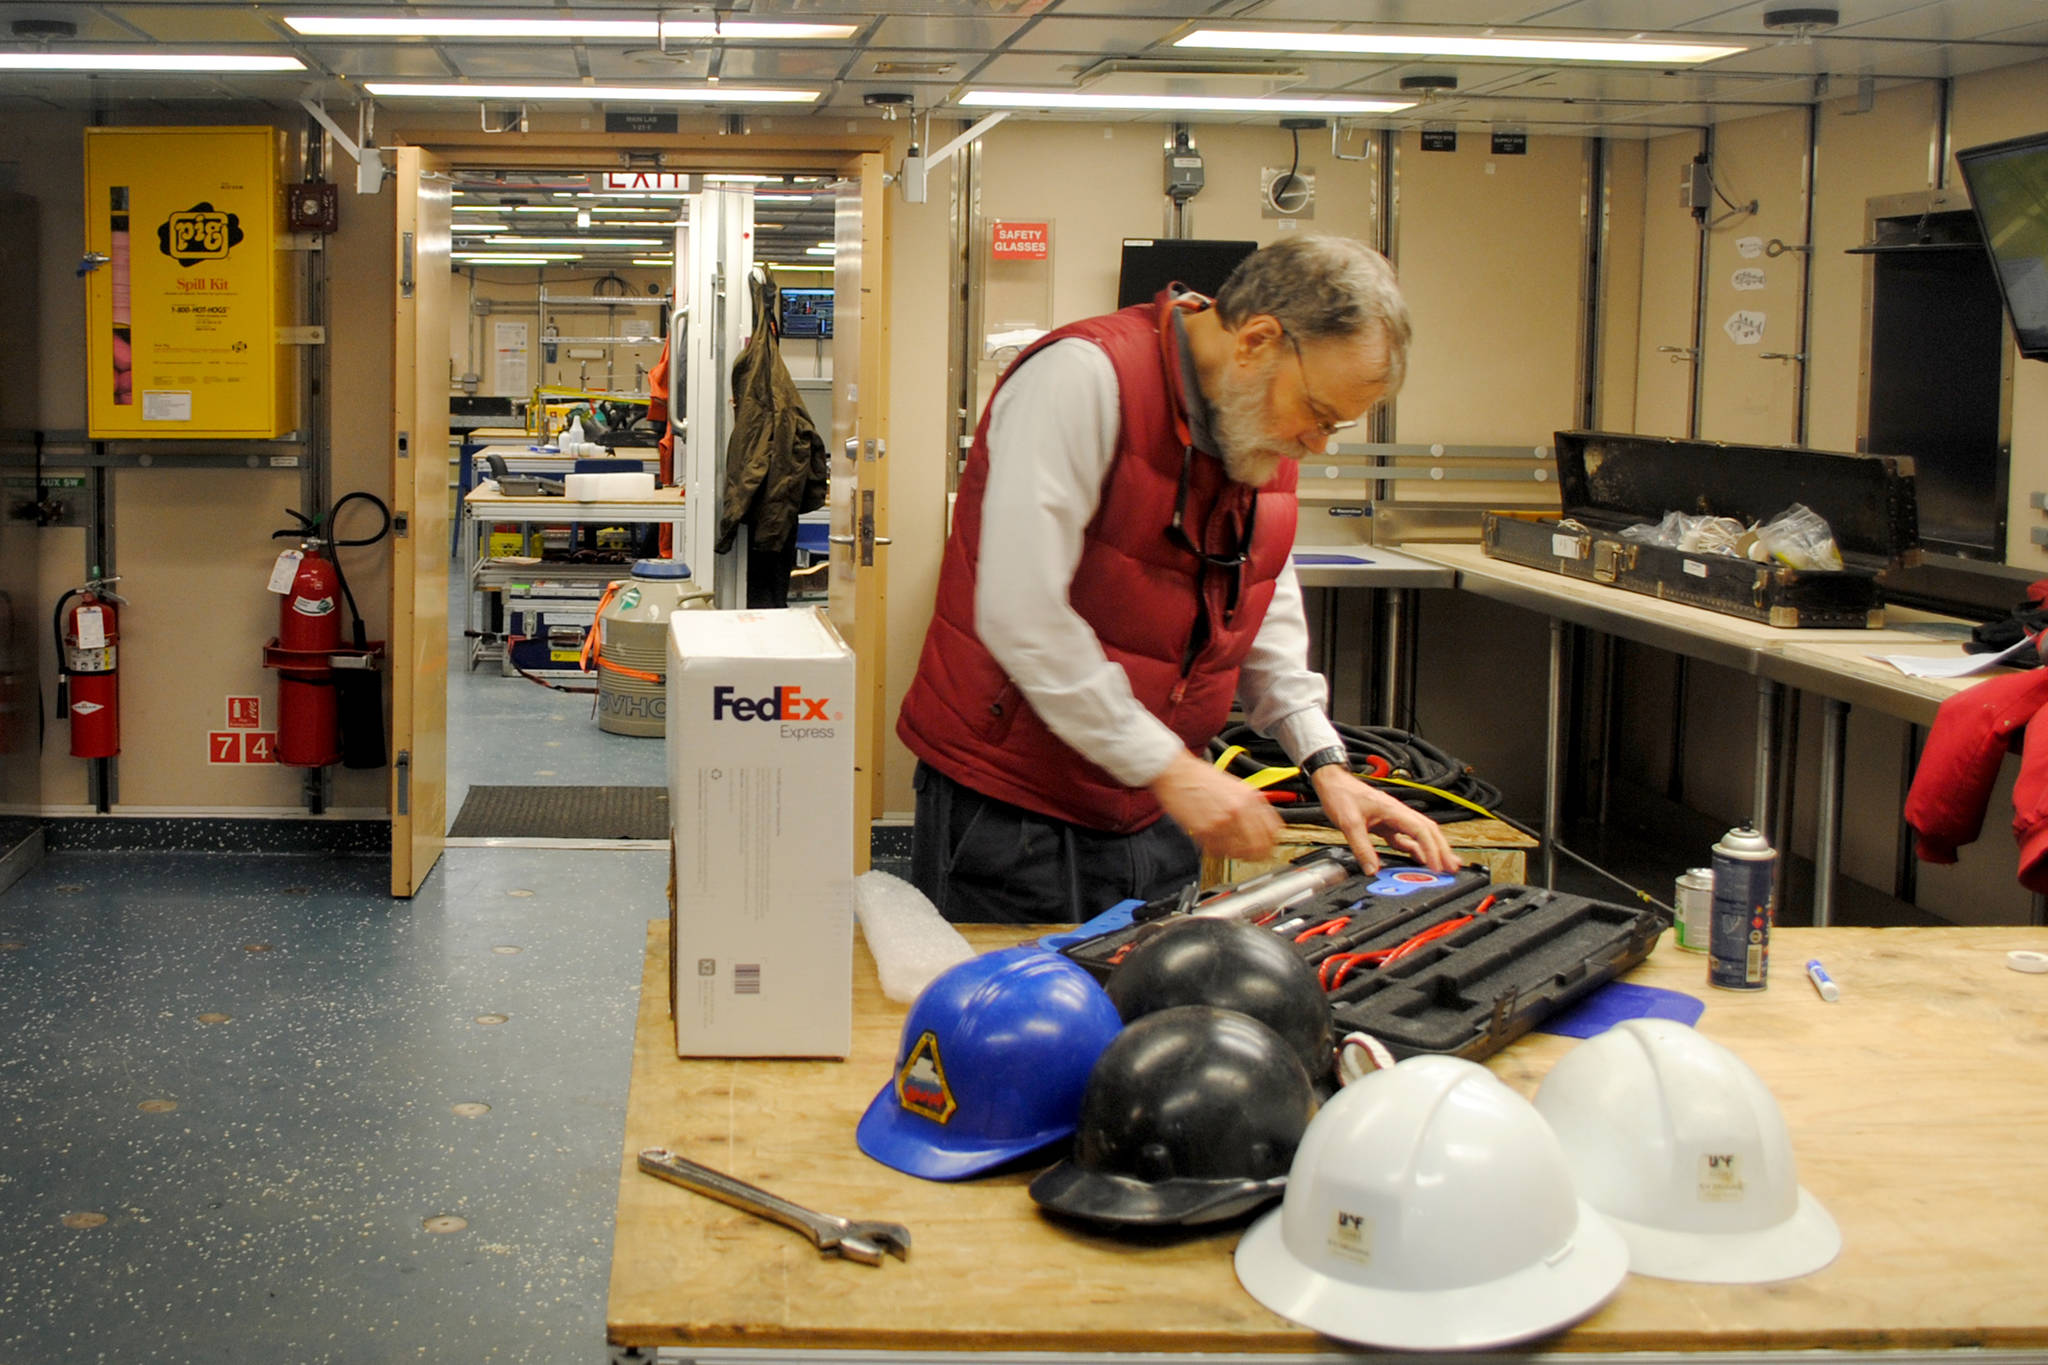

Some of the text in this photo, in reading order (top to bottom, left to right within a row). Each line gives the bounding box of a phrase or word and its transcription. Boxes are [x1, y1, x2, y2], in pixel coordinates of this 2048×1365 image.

[999, 230, 1042, 240] SAFETY
[994, 241, 1046, 252] GLASSES
[176, 278, 229, 292] Spill Kit
[40, 478, 61, 487] AUX
[713, 685, 830, 722] FedEx
[780, 724, 835, 741] Express
[217, 736, 269, 760] 7 4
